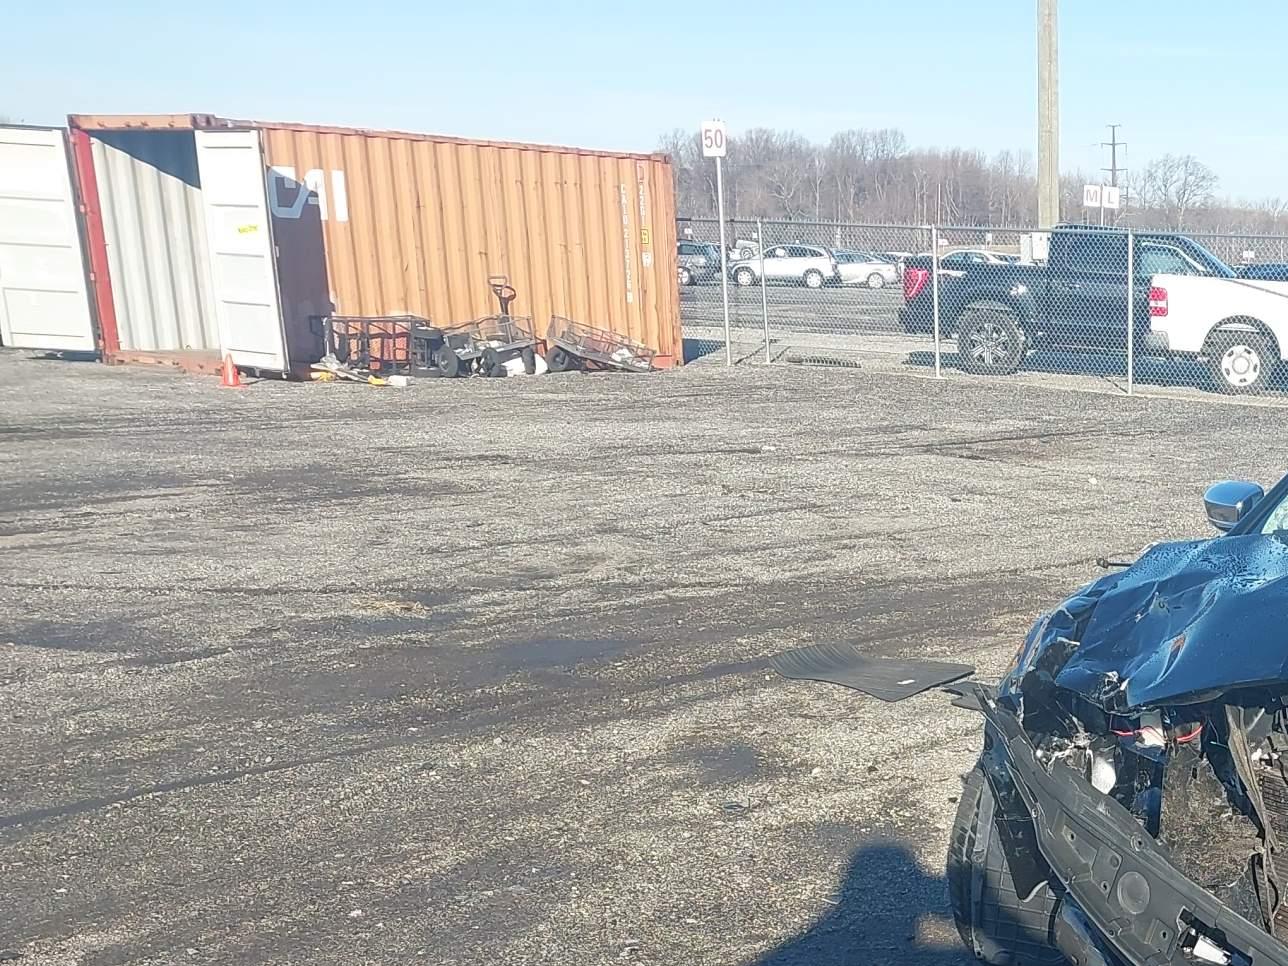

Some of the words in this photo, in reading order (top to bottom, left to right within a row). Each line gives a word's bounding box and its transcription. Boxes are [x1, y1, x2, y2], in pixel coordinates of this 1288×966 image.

[704, 128, 723, 149] 50
[267, 165, 349, 222] CAI
[1086, 189, 1098, 202] M
